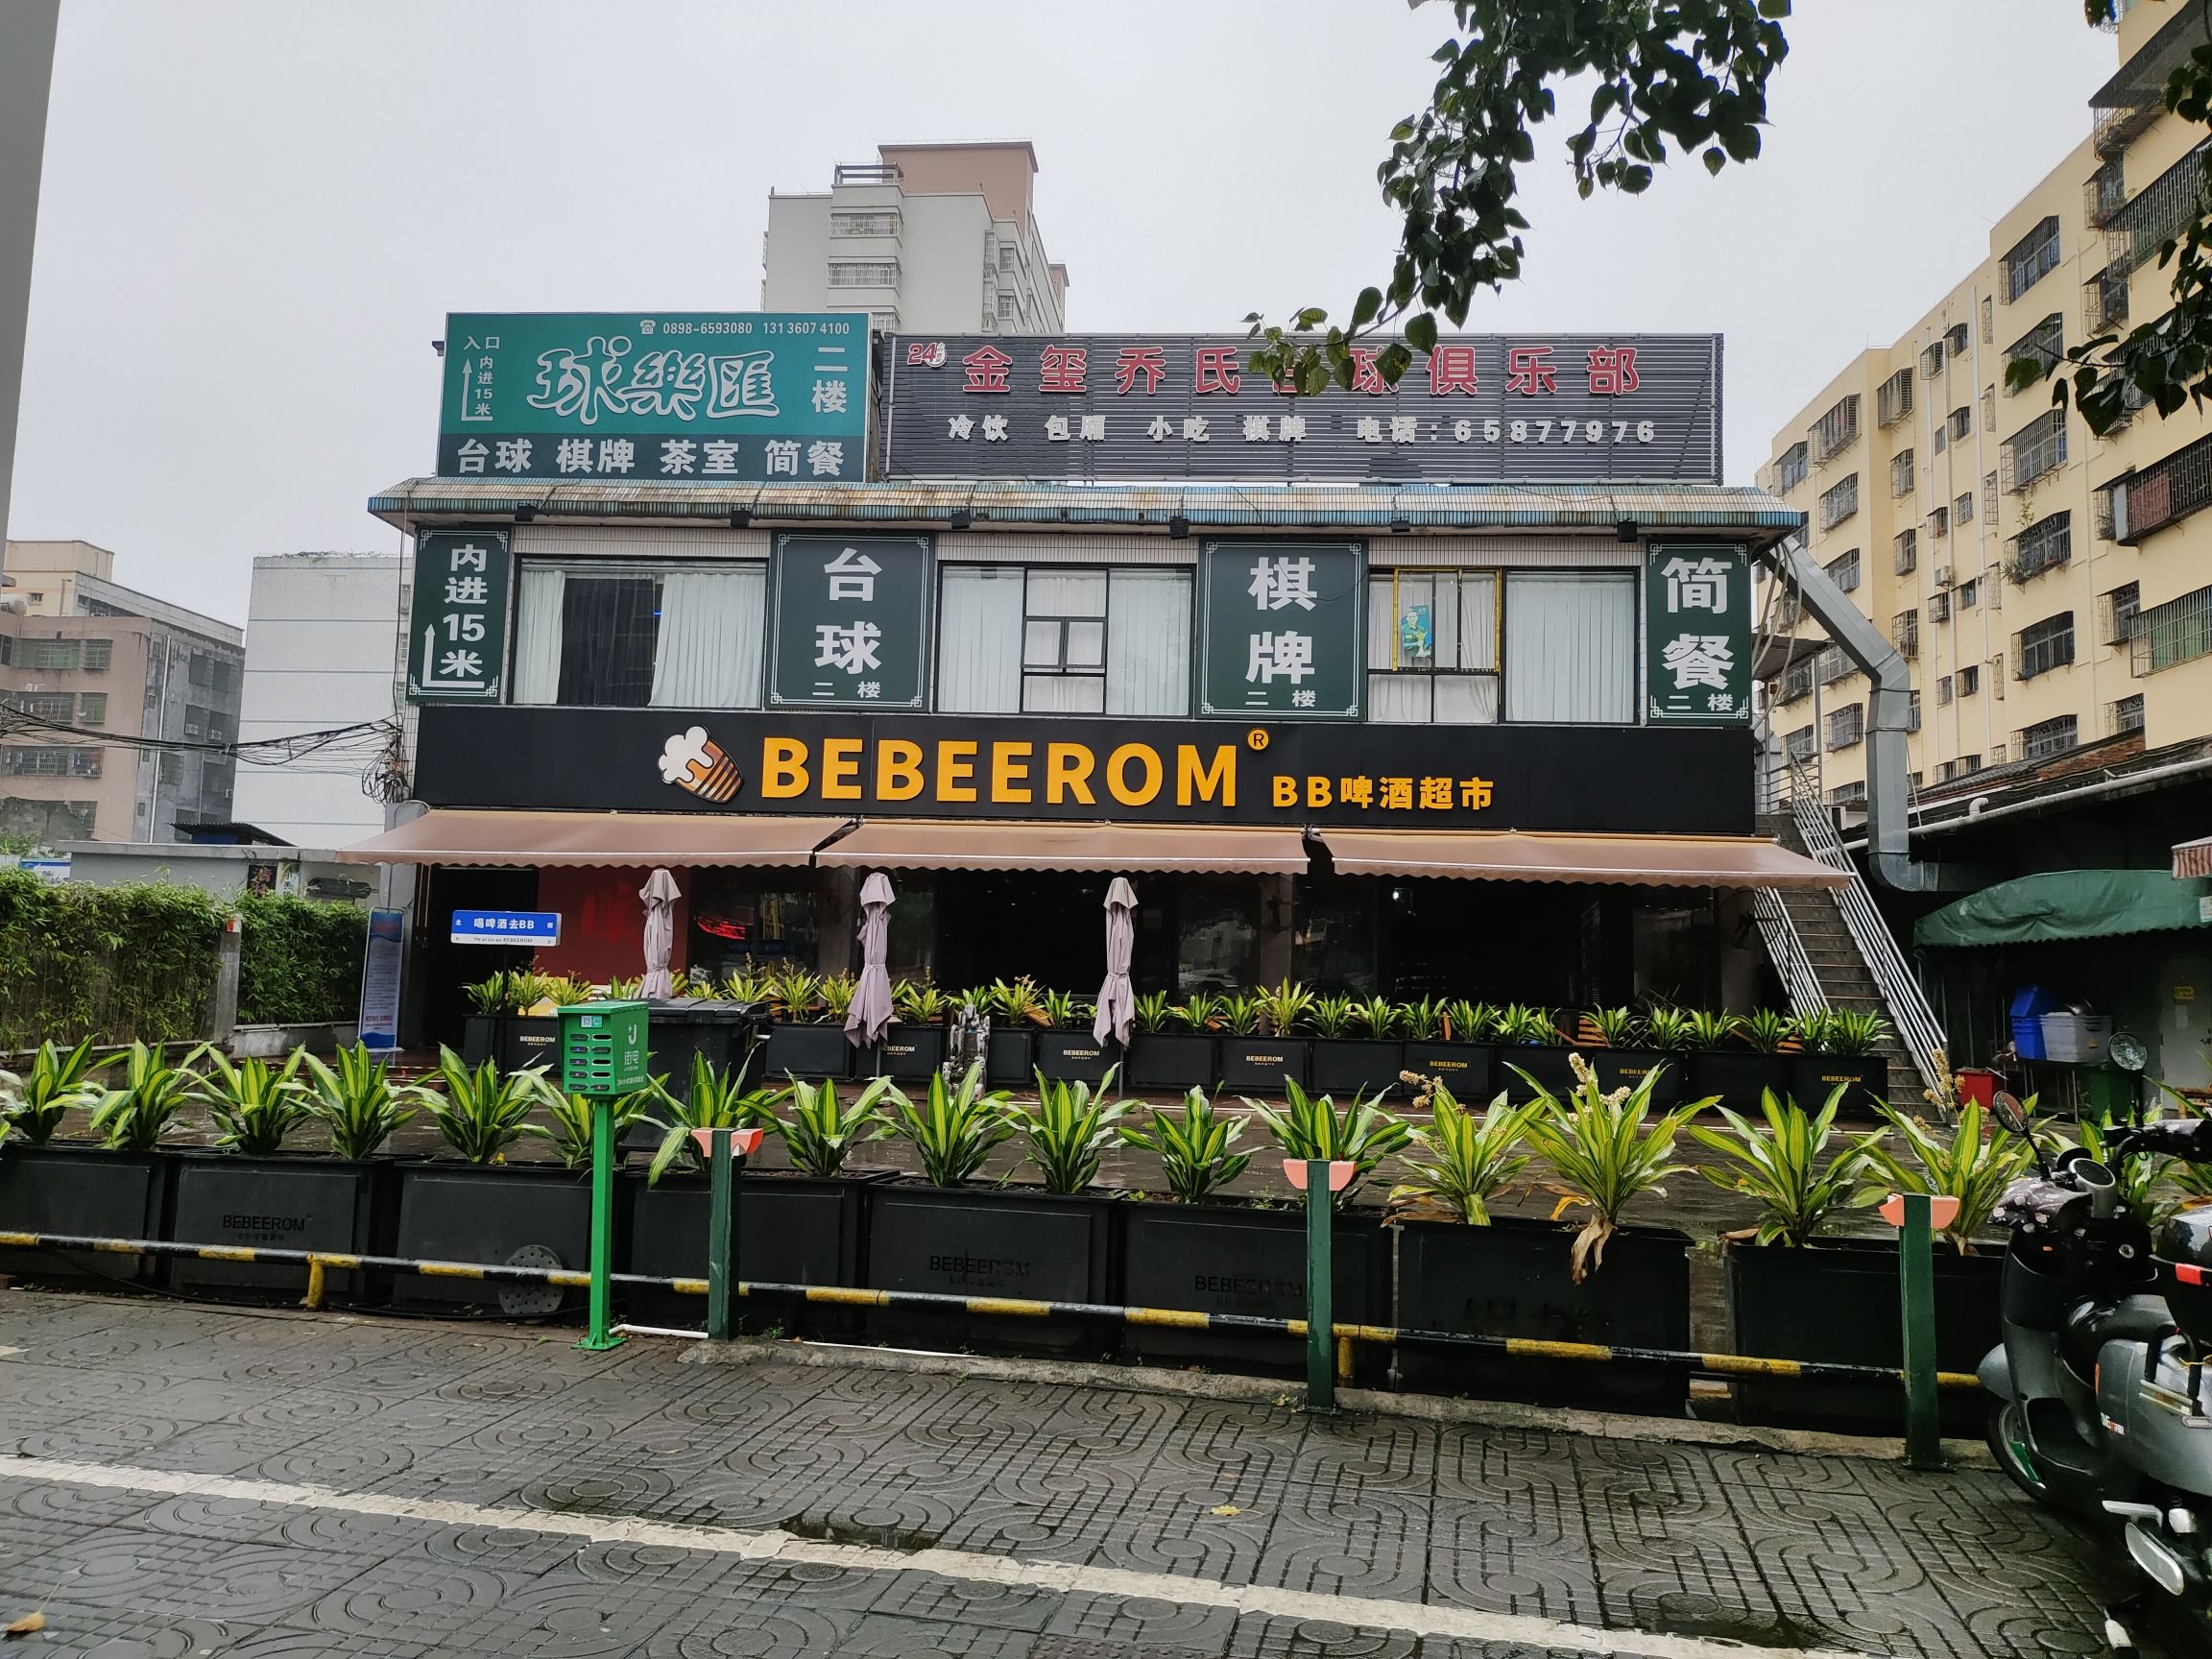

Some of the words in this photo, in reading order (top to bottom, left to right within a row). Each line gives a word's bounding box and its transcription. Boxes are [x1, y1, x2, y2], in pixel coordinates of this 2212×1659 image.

[464, 336, 500, 350] 入口
[663, 322, 753, 334] 0898-6593080
[812, 347, 849, 414] 二楼
[962, 344, 1641, 396] 金玺乔氏球俱乐部
[948, 413, 1008, 442] 冷饮
[1044, 414, 1106, 443] 包厢
[1147, 416, 1210, 443] 小吃
[1243, 415, 1307, 443] 棋牌
[457, 438, 533, 473] 台球
[556, 439, 636, 474] 棋牌
[660, 439, 739, 475] 茶室
[763, 439, 845, 477] 简餐
[815, 547, 883, 676] 台球
[1245, 556, 1318, 685] 棋牌
[1660, 557, 1735, 691] 简餐
[812, 680, 882, 699] 二楼
[1245, 689, 1317, 708] 二楼
[1667, 693, 1735, 712] 二楼
[760, 736, 1238, 807] BEBEEROM
[222, 1214, 305, 1232] BEBEEROM
